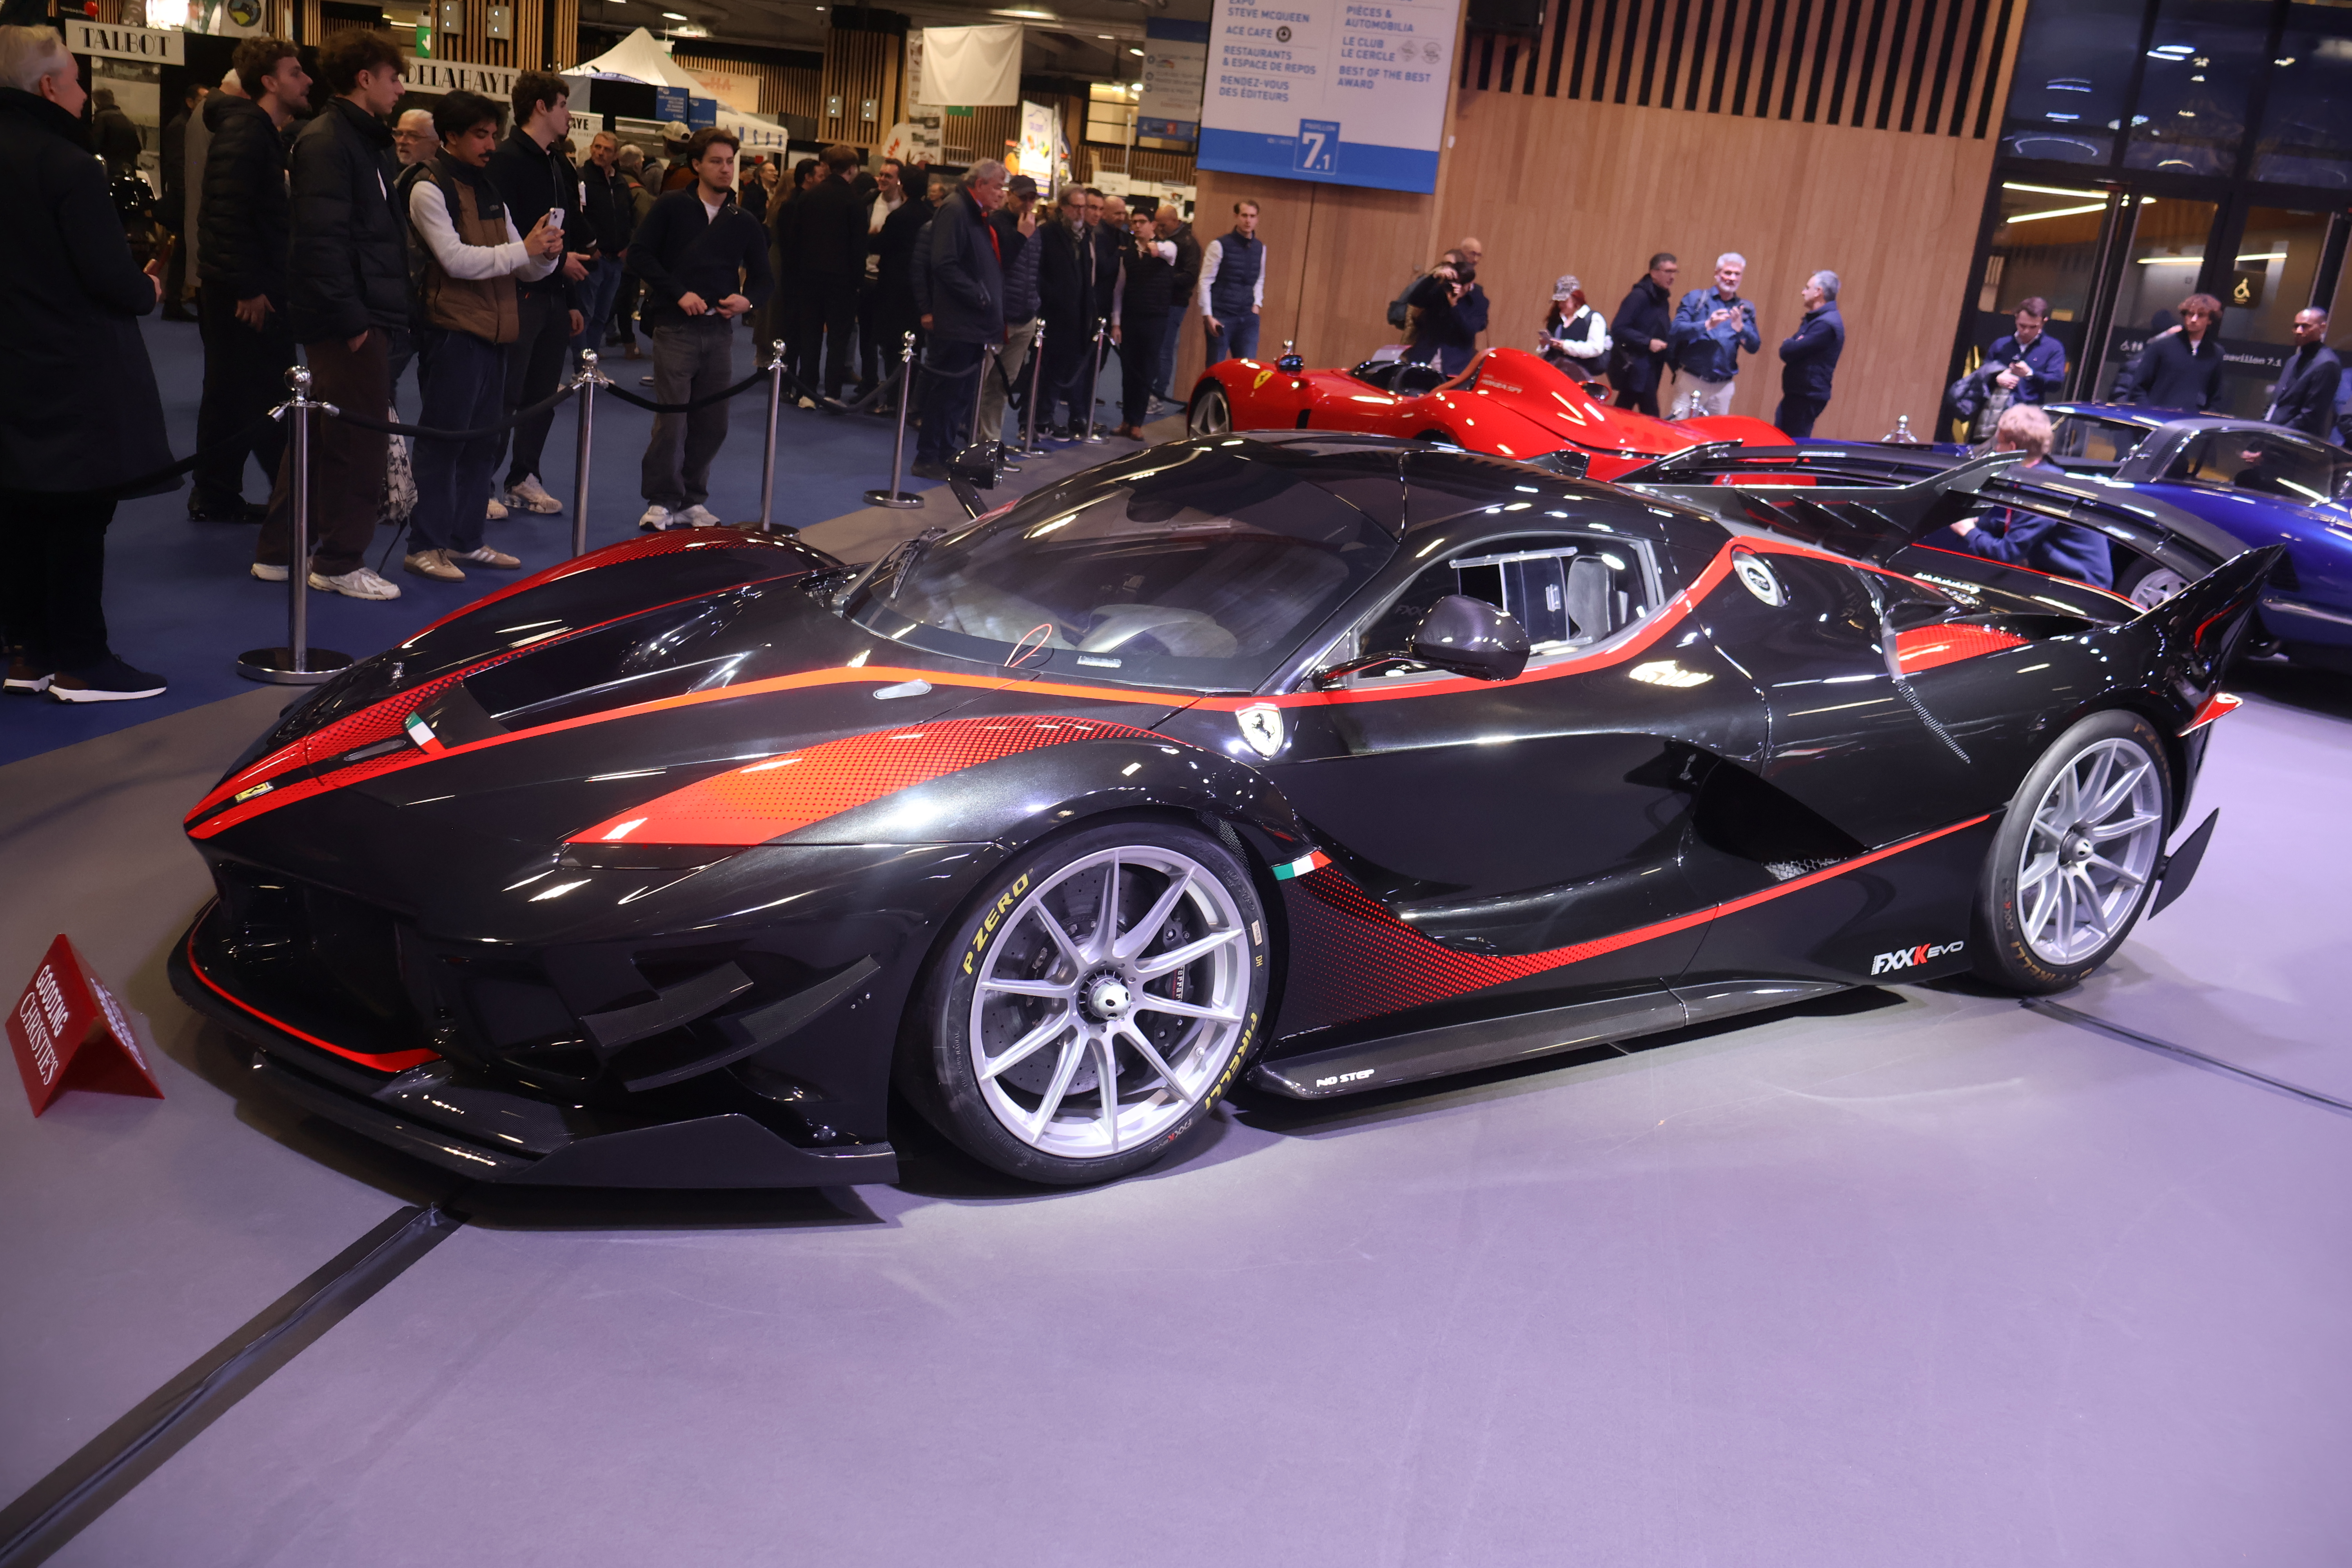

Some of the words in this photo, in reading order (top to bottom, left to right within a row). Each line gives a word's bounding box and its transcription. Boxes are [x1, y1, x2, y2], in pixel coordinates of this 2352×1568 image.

[1227, 7, 1258, 18] STEVE
[1261, 10, 1310, 22] MCQUEEN
[1347, 5, 1382, 17] PIÈCES
[1385, 9, 1392, 18] &
[1226, 26, 1245, 35] ACE
[1247, 27, 1272, 38] CAFE
[1345, 18, 1414, 32] AUTOMOBILIA
[79, 27, 170, 57] TALBOT
[1343, 36, 1355, 46] LE
[1357, 38, 1384, 48] CLUB
[1224, 45, 1292, 60] RESTAURANTS
[1341, 49, 1353, 58] LE
[1356, 50, 1396, 62] CERCLE
[1222, 58, 1229, 66] &
[1232, 58, 1267, 70] ESPACE
[1270, 62, 1282, 71] DE
[1285, 64, 1316, 74] REPOS
[1339, 65, 1365, 76] BEST
[1367, 69, 1380, 77] OF
[1383, 70, 1402, 80] THE
[1405, 72, 1431, 82] BEST
[403, 64, 515, 94] DELAHAYE
[1221, 75, 1289, 90] RENDEZ-VOUS
[1337, 78, 1374, 89] AWARD
[1219, 87, 1238, 97] DES
[1240, 87, 1289, 102] ÉDITEURS
[973, 873, 1029, 952] ZERO
[1927, 941, 1964, 958] EVO
[1256, 955, 1263, 967] DH
[36, 964, 69, 1038] GOODING
[20, 992, 58, 1085] CHRISTIE'S
[1205, 1013, 1258, 1110] PIRELLI
[1316, 1076, 1338, 1087] NO
[1339, 1069, 1375, 1083] STEP
